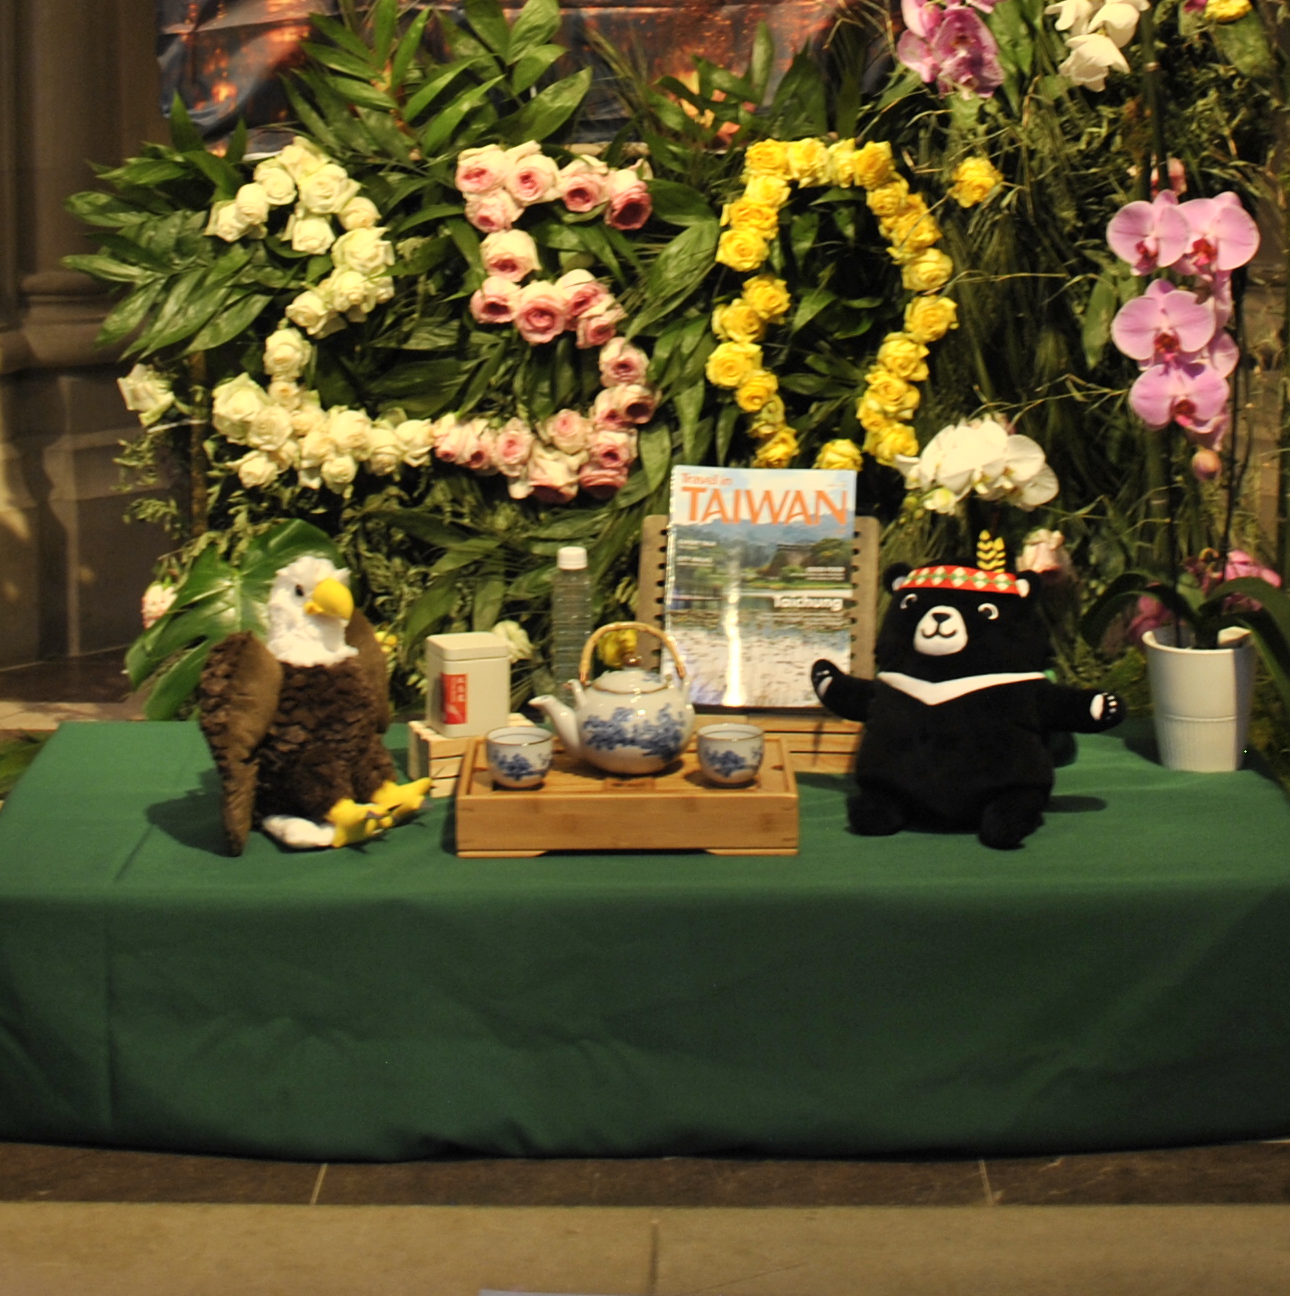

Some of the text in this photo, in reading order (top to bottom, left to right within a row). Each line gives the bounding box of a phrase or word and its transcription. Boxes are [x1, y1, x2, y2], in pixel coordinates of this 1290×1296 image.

[681, 473, 733, 487] Travel in
[681, 486, 849, 526] TAIWAN
[773, 596, 844, 611] Taichung
